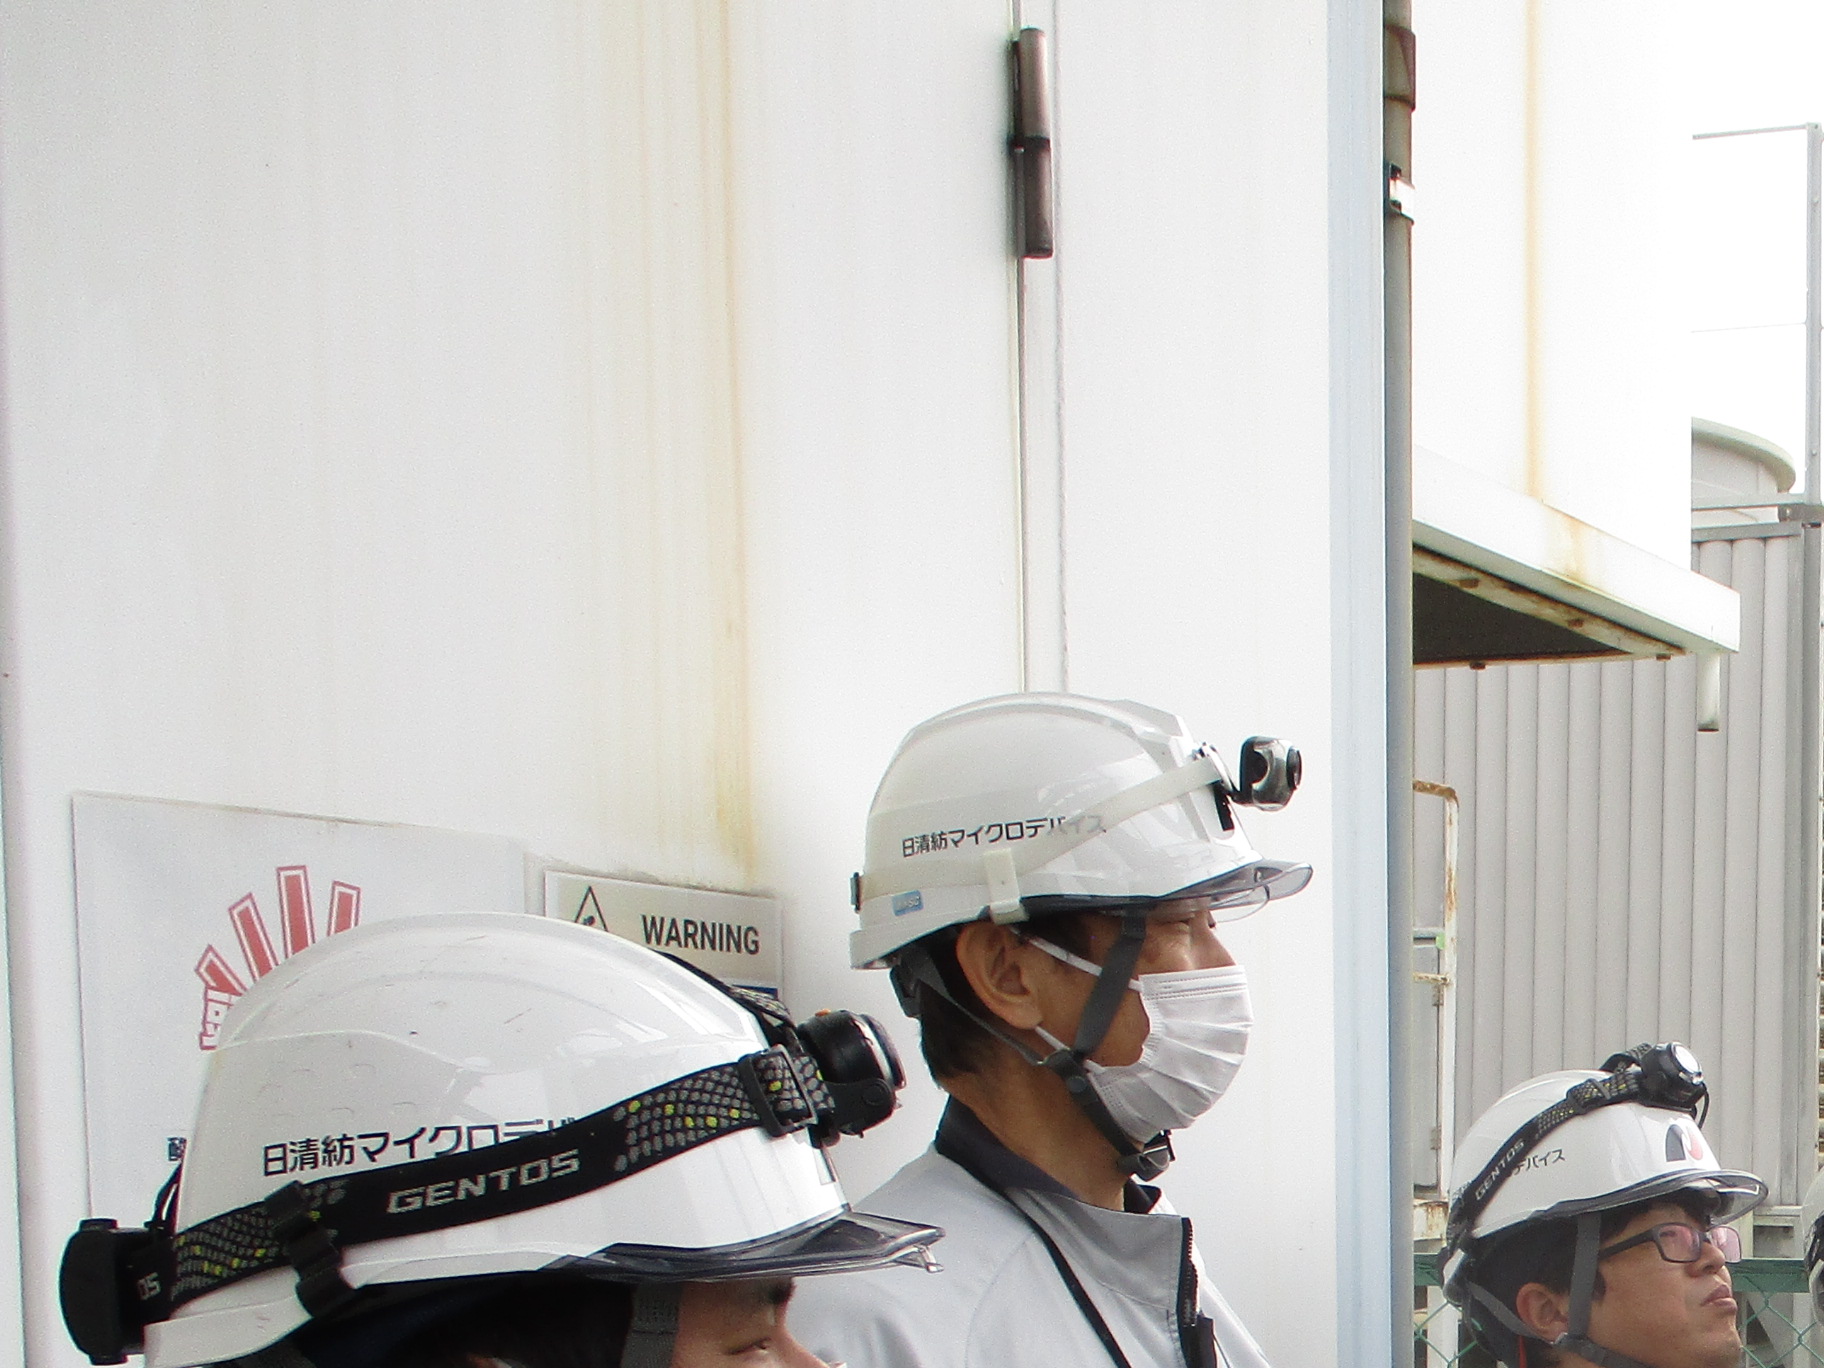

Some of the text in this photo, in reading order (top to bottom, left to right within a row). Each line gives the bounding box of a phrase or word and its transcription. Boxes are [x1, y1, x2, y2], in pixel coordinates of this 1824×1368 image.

[641, 914, 760, 955] WARNING
[386, 1149, 581, 1214] GENTOS
[1474, 1138, 1525, 1200] GENTOS
